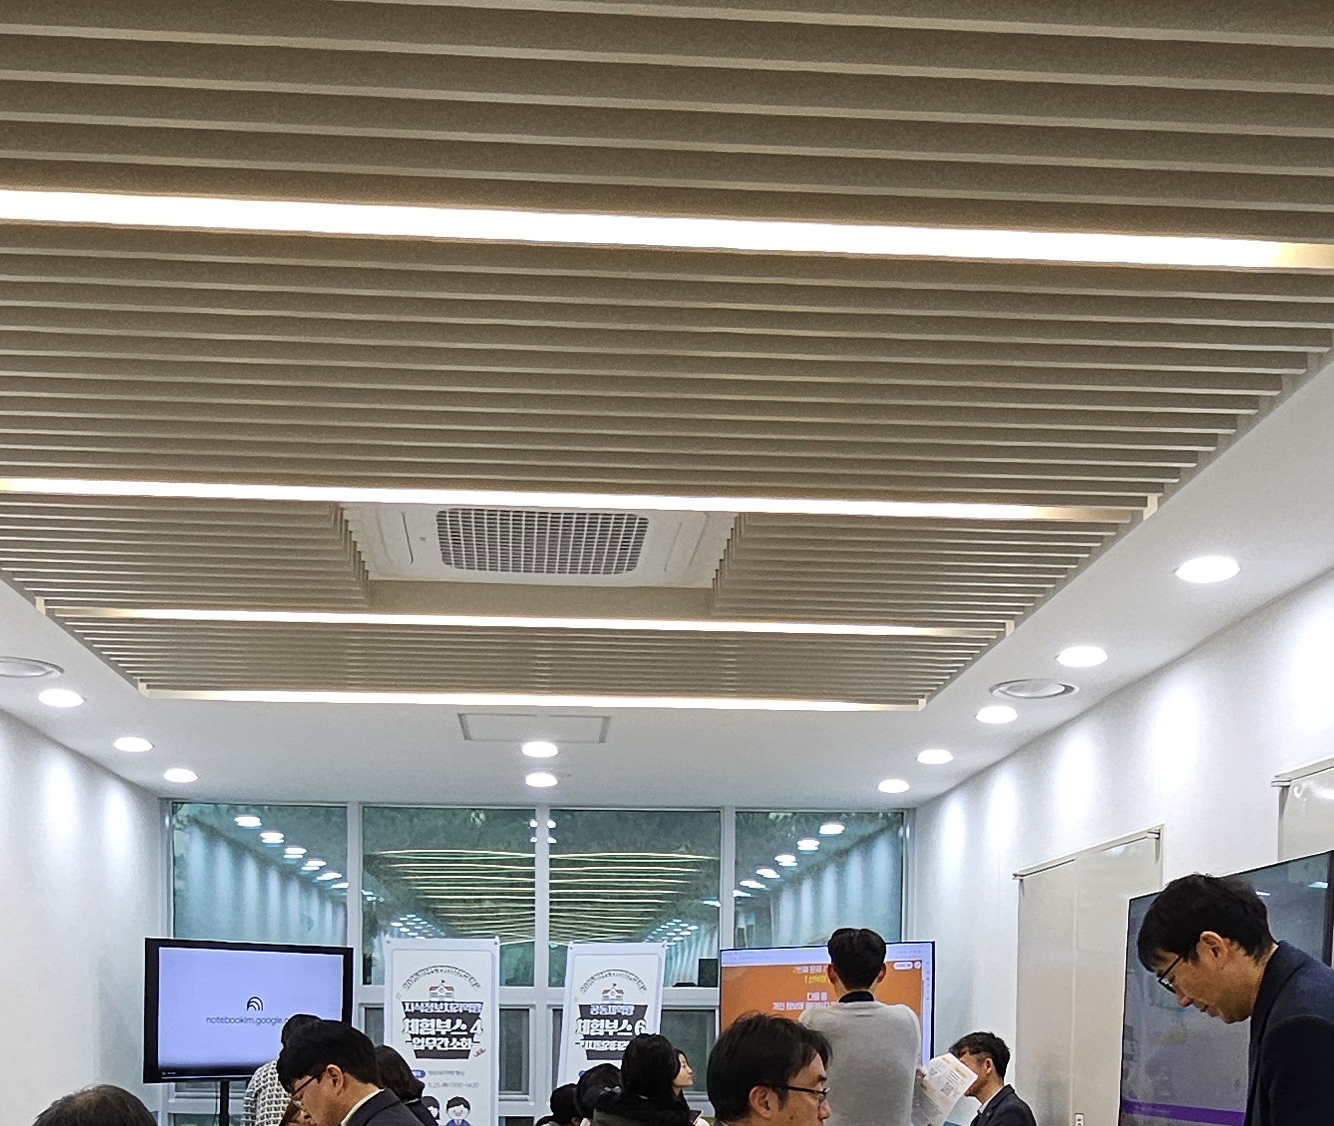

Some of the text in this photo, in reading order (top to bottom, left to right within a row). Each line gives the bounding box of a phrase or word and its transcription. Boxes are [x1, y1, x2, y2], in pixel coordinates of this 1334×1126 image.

[403, 1018, 483, 1035] 체험부스 4
[575, 1018, 633, 1036] 체험부스
